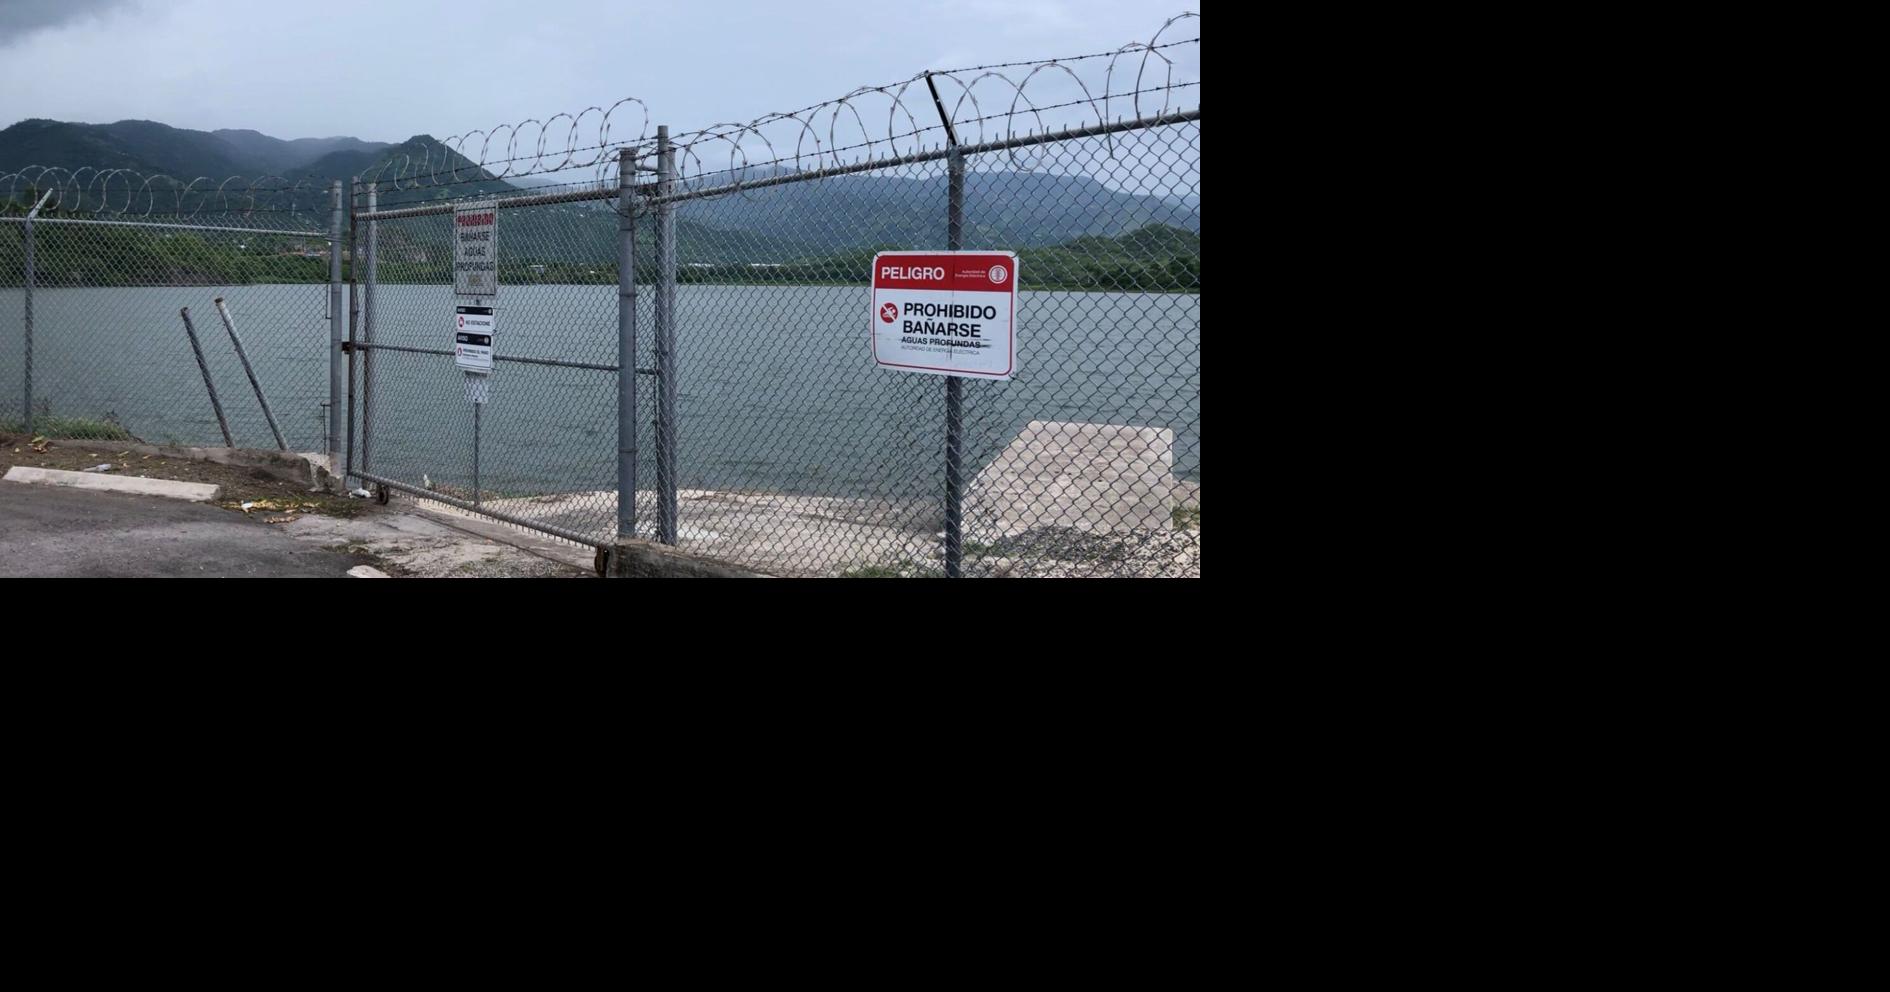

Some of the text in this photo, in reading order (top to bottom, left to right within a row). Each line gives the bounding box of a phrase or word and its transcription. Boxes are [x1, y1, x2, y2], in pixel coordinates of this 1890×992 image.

[464, 246, 486, 257] AGUAS
[881, 266, 945, 280] PELIGRO
[903, 302, 997, 320] PROHIBIDO
[902, 318, 982, 338] BAÑARSE
[901, 336, 981, 349] AGUAS PROFUNDAS
